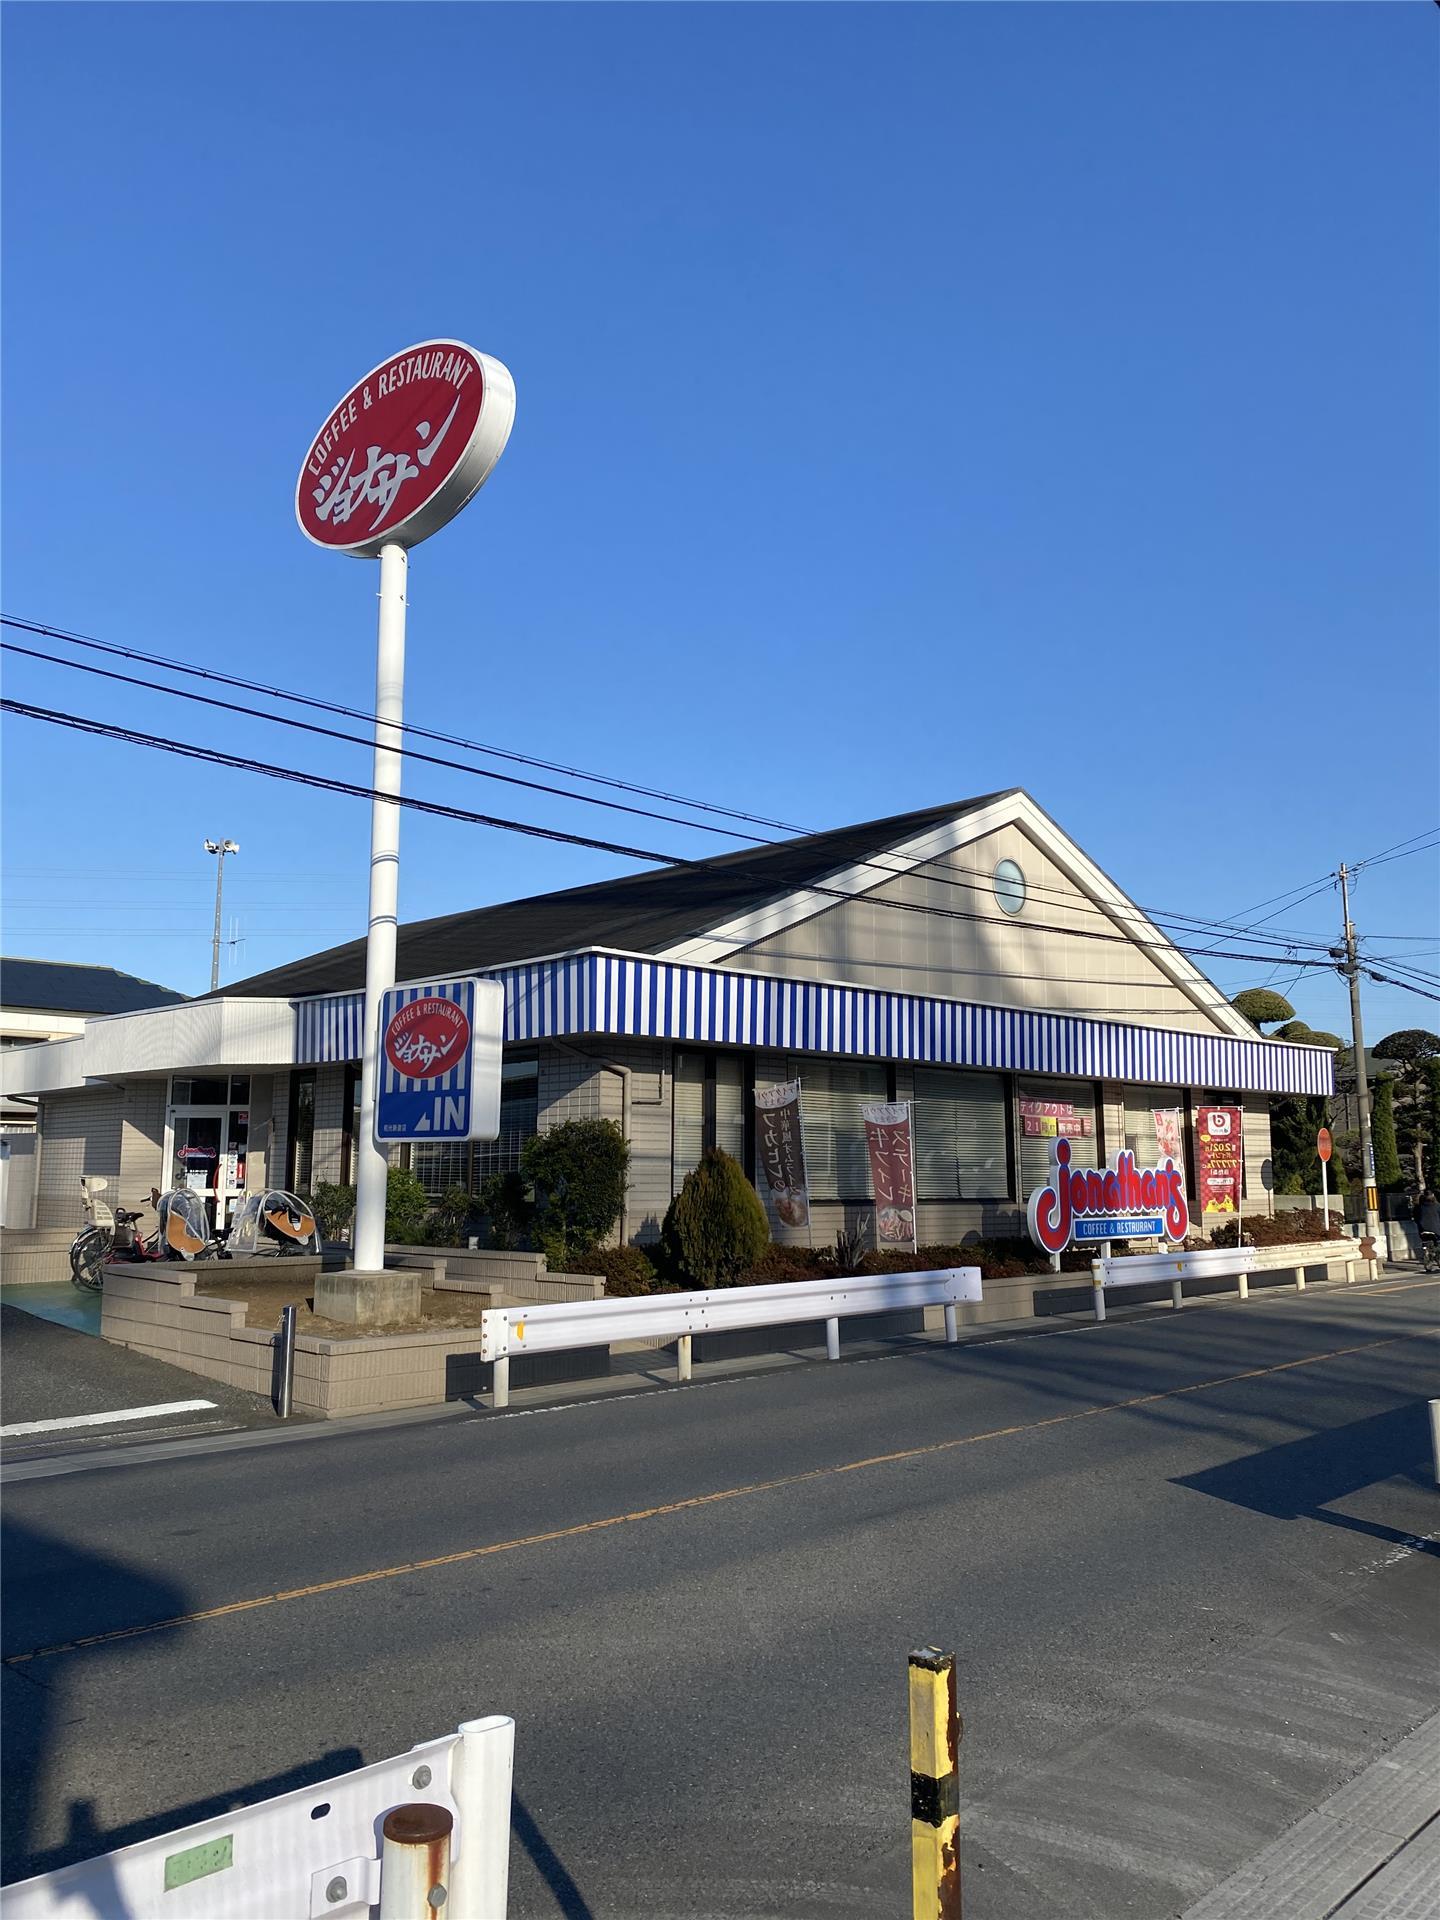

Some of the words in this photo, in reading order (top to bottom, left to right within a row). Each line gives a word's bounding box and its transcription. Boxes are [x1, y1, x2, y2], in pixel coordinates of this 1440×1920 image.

[307, 398, 358, 476] COFFEE
[362, 386, 373, 410] &
[378, 351, 474, 400] RESTAURANT
[311, 393, 462, 532] ジョナサン
[391, 1009, 414, 1036] COFFEE
[416, 1005, 422, 1017] &
[423, 1002, 464, 1030] RESTAURANT
[393, 1030, 460, 1073] ジョナサン
[433, 1095, 465, 1131] IN
[1020, 1100, 1074, 1115] テイクアウトは
[1083, 1222, 1108, 1235] COFFEE
[1110, 1221, 1115, 1234] &
[1116, 1220, 1156, 1234] RESTAURANT
